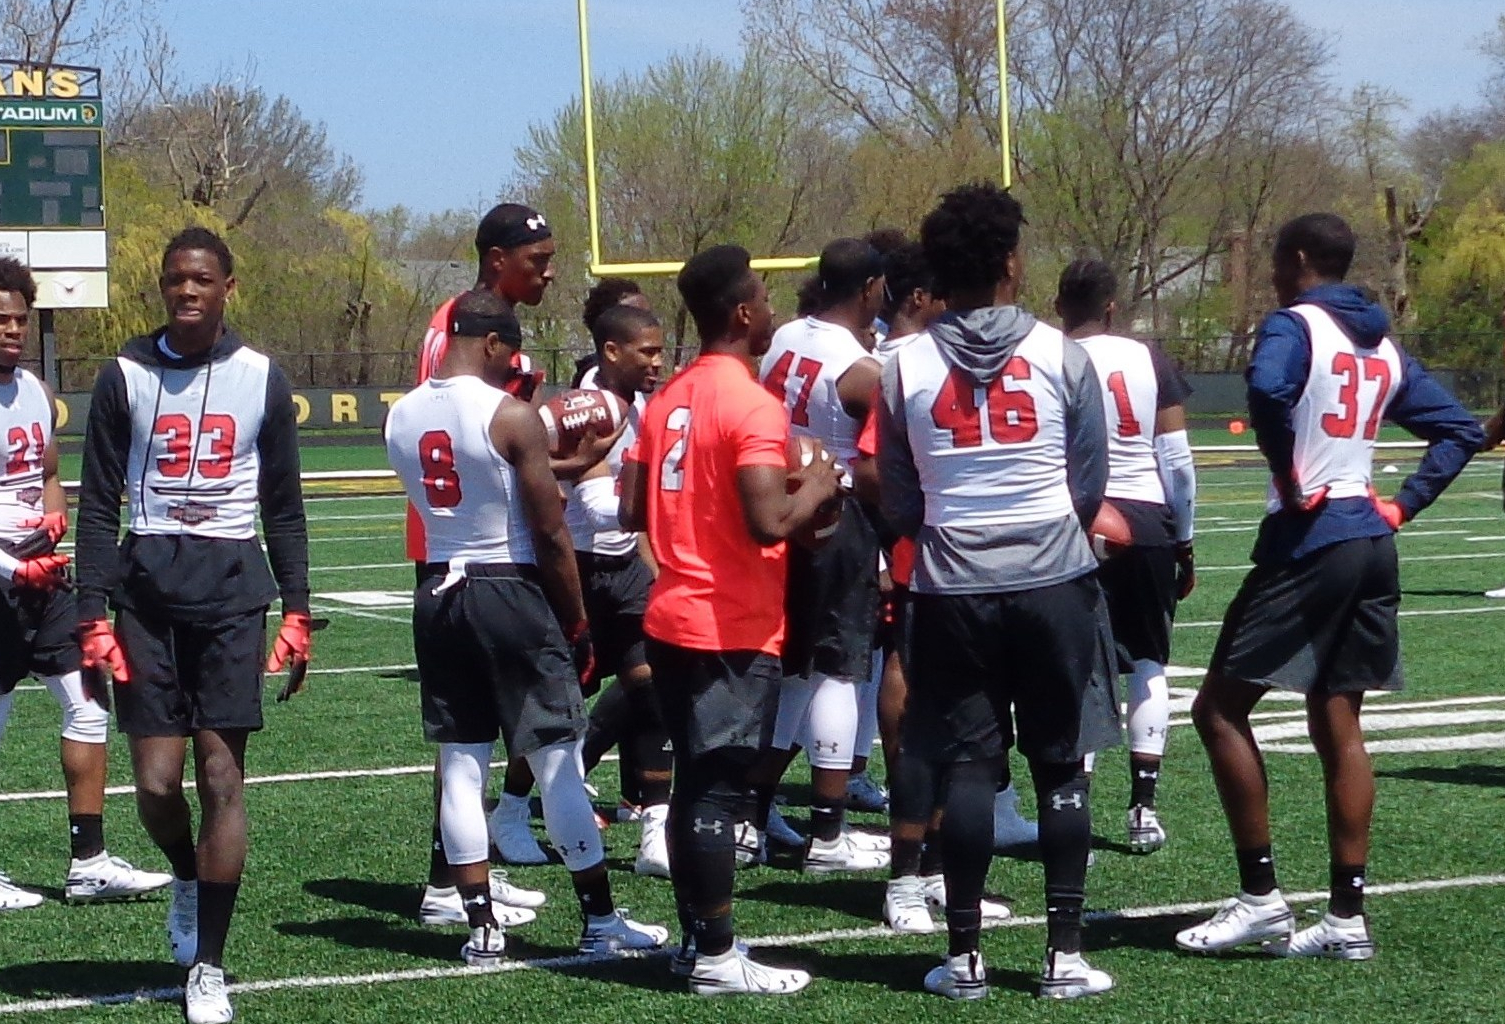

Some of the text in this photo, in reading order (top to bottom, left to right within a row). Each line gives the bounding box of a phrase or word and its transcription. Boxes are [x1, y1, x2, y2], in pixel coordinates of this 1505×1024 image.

[763, 350, 824, 428] 47
[930, 355, 1039, 448] 46
[1107, 370, 1142, 437] 1
[1320, 352, 1391, 441] 37
[5, 421, 45, 475] 21
[153, 413, 237, 480] 33
[418, 430, 463, 509] 8
[660, 406, 693, 492] 2
